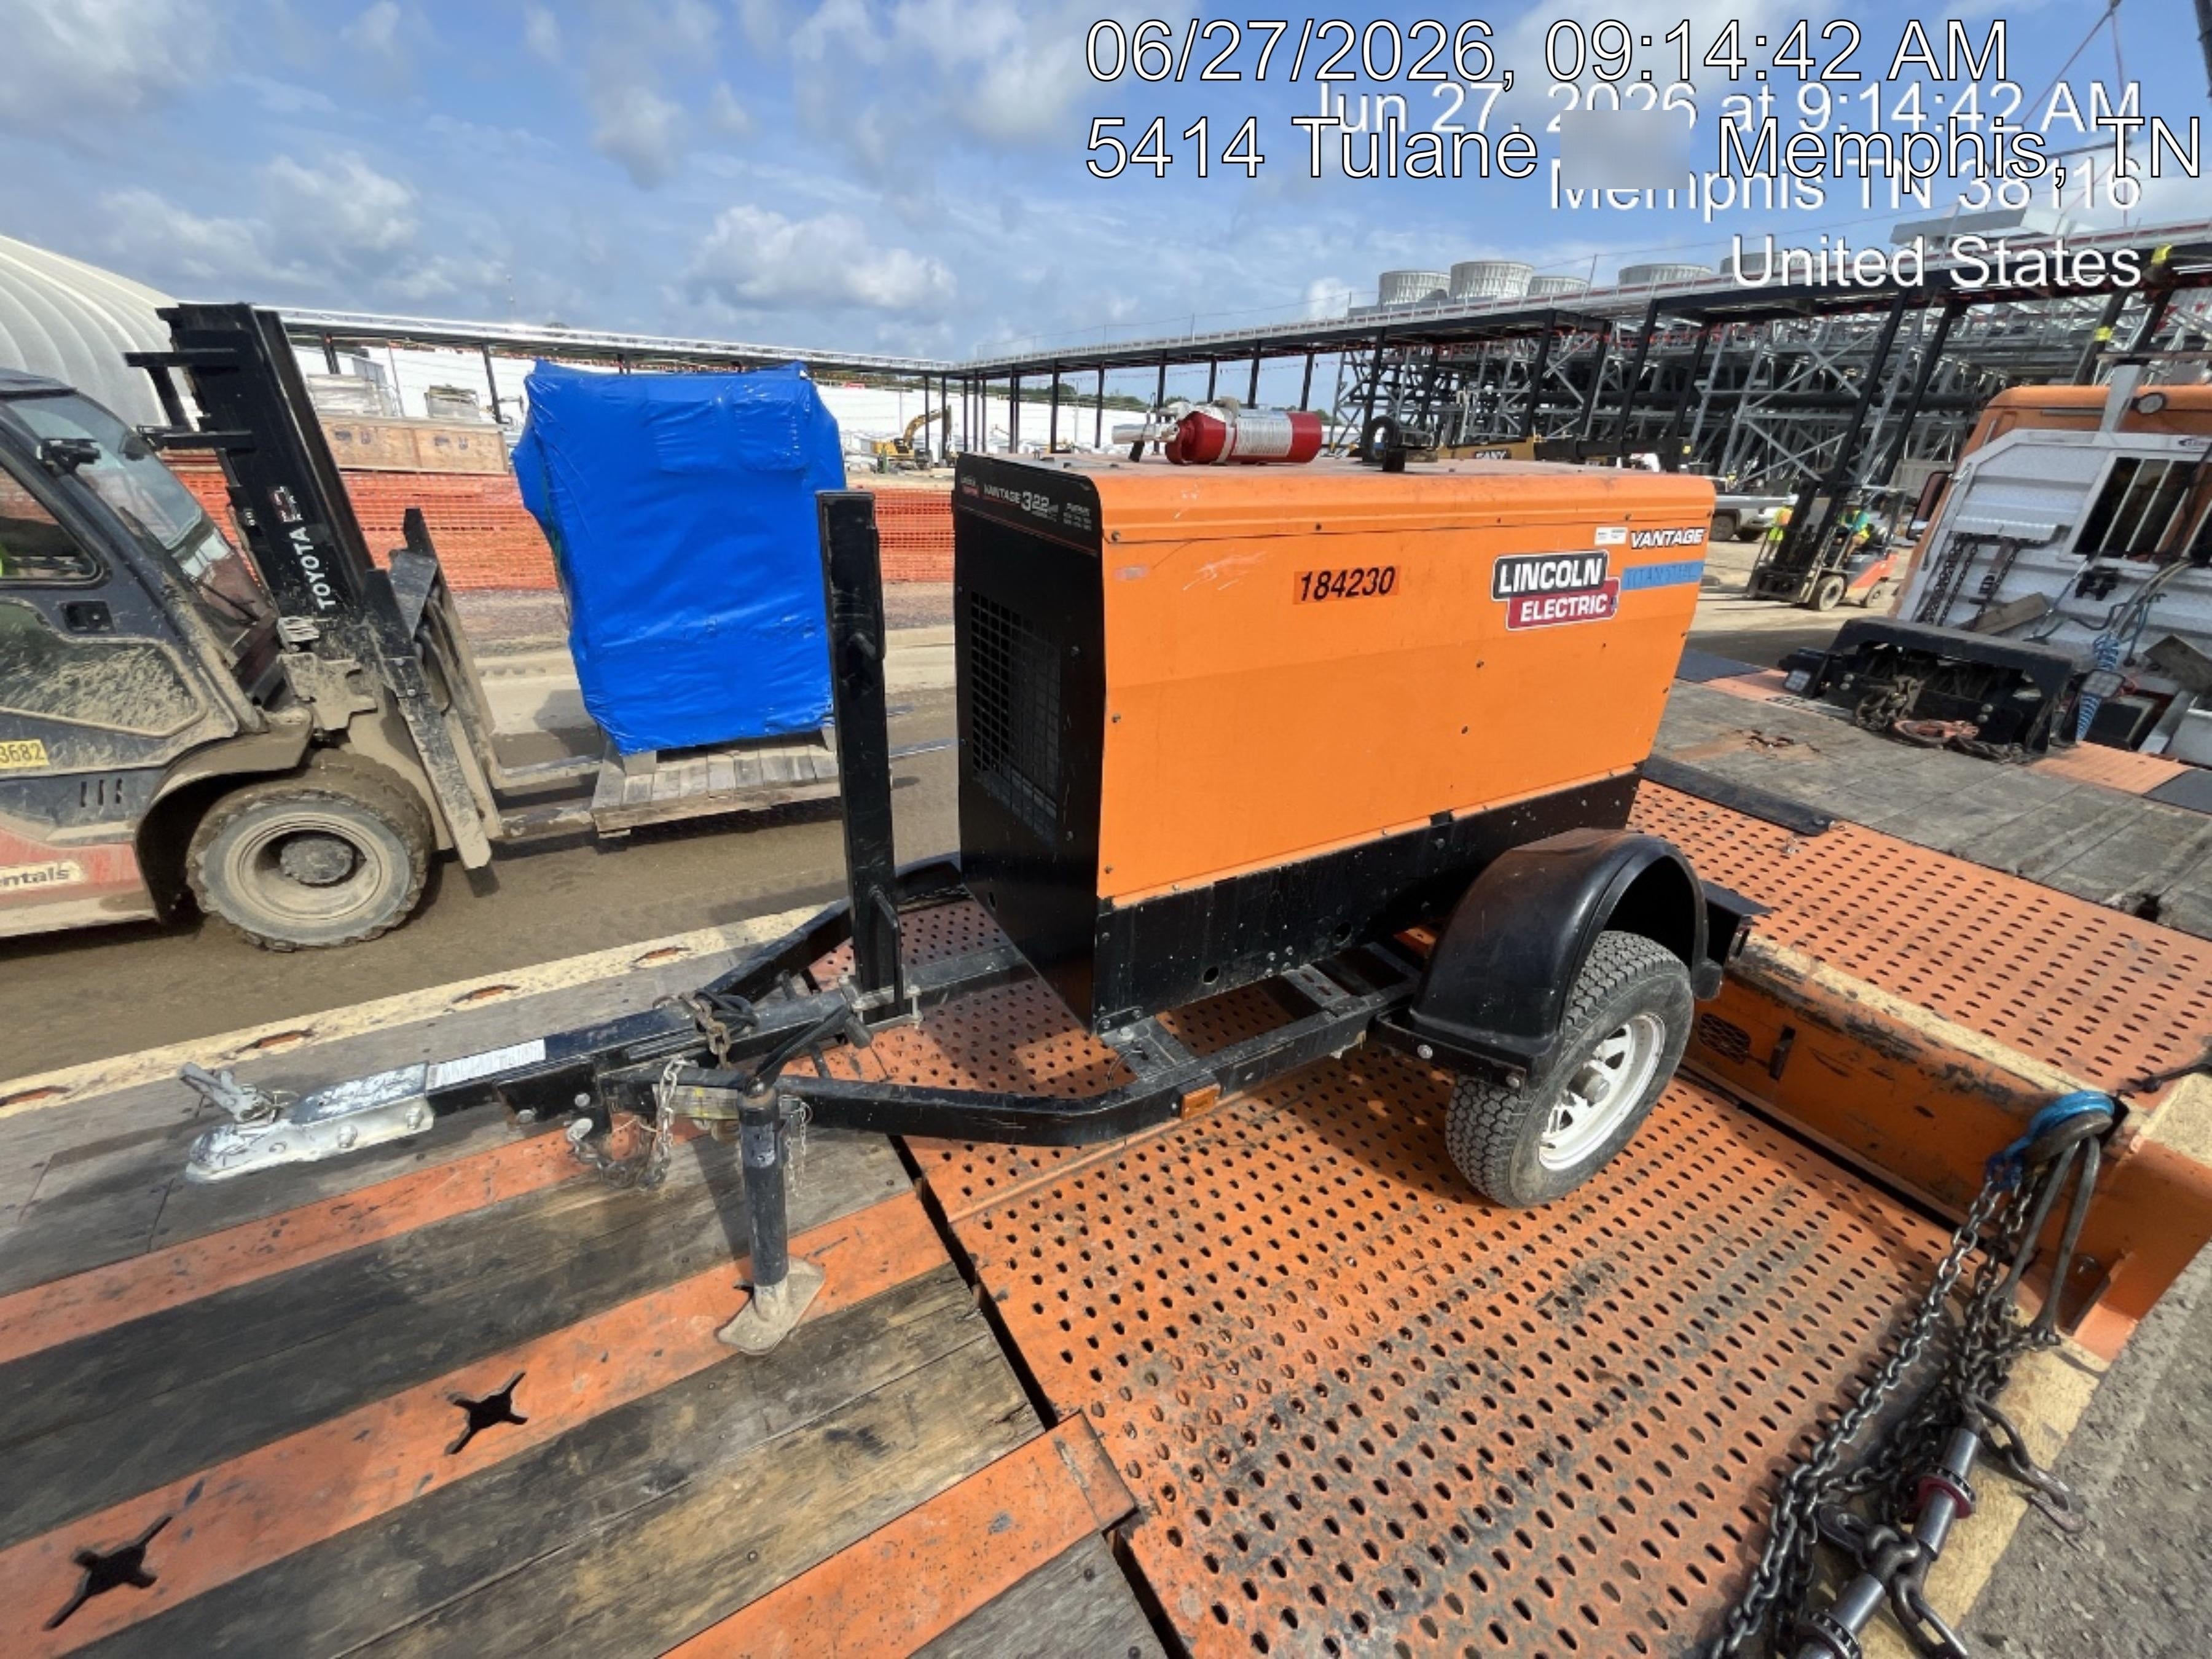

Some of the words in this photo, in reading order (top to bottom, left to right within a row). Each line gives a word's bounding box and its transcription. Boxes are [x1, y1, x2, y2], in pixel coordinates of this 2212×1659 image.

[1021, 491, 1049, 513] 322
[1631, 527, 1705, 549] VANTAGE
[289, 527, 336, 610] TOYOTA
[1498, 558, 1602, 594] LINCOLN
[1301, 565, 1395, 602] 184230
[1520, 594, 1608, 622] ELECTRIC
[0, 866, 69, 887] ntals
